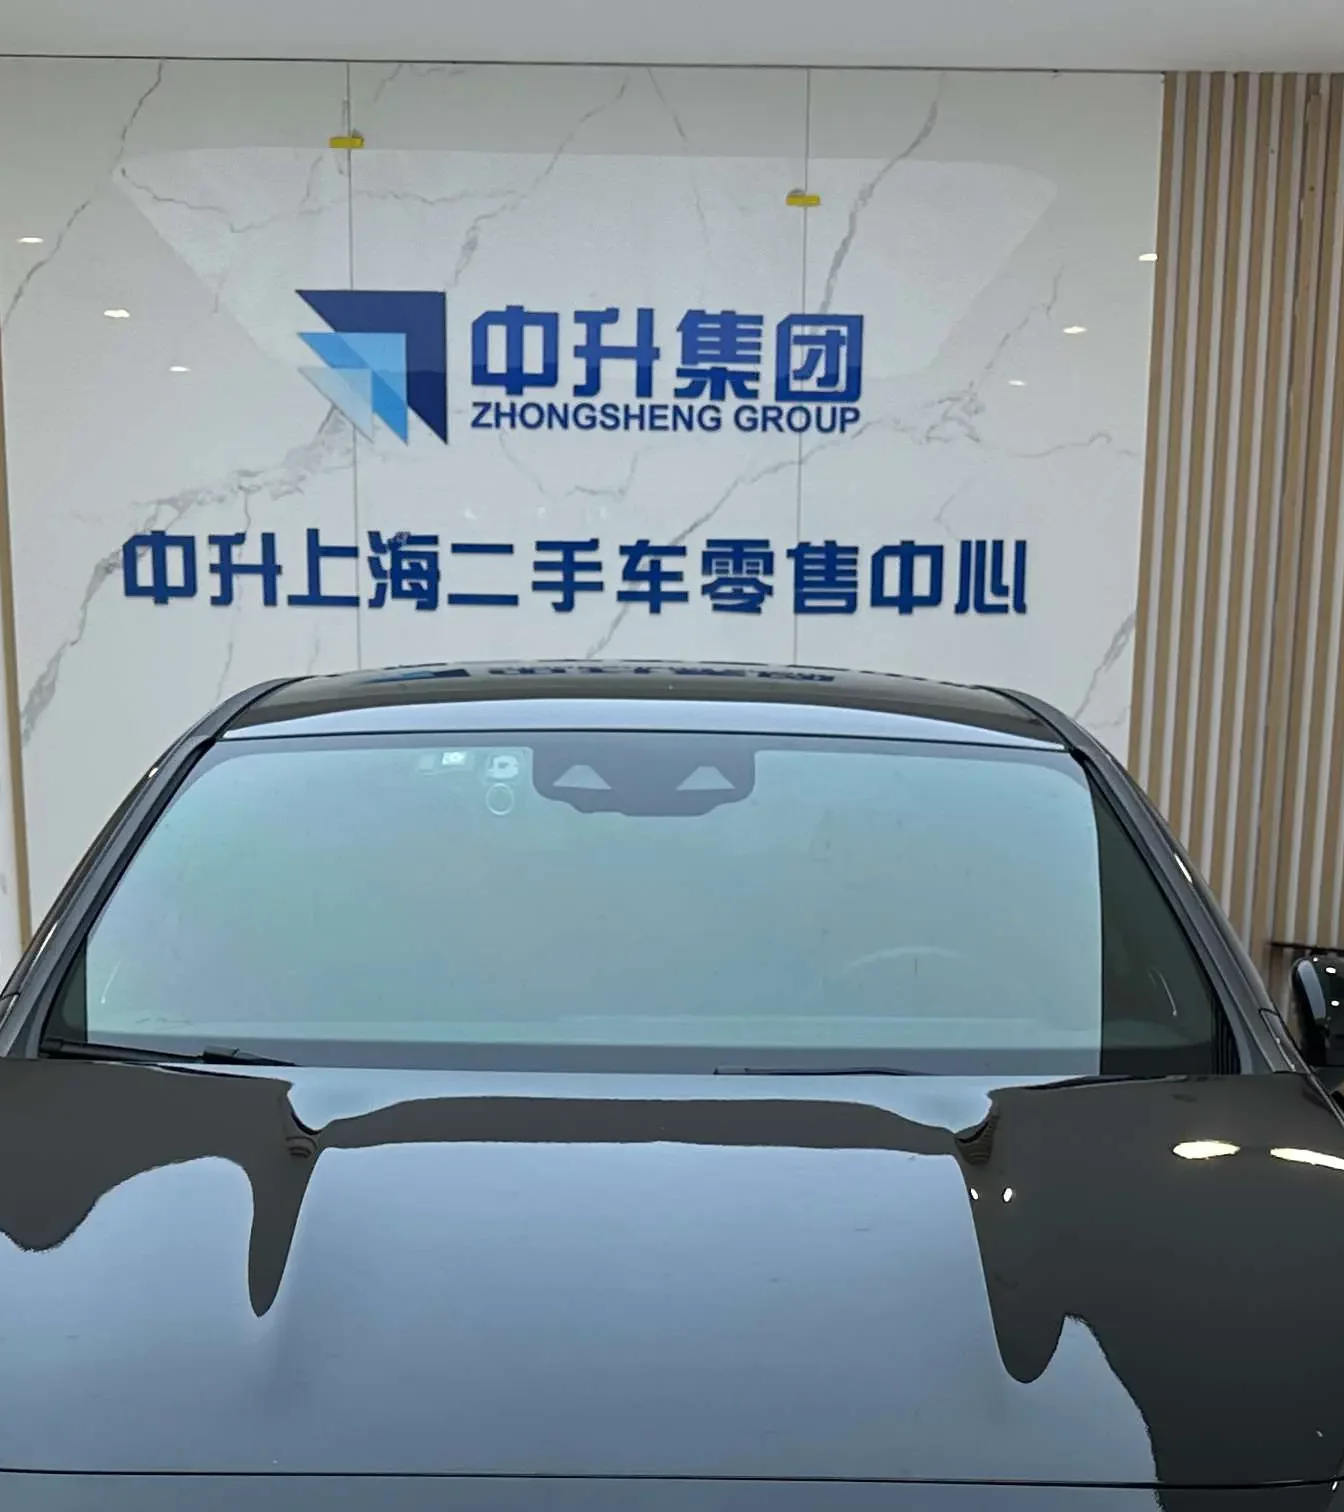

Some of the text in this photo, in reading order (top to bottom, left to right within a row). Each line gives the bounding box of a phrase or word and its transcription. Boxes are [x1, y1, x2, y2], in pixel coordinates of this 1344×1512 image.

[470, 305, 864, 402] 中升集团
[471, 402, 862, 433] ZHONGSHENG GROUP
[123, 528, 1028, 615] 中升上海二手车零售中心
